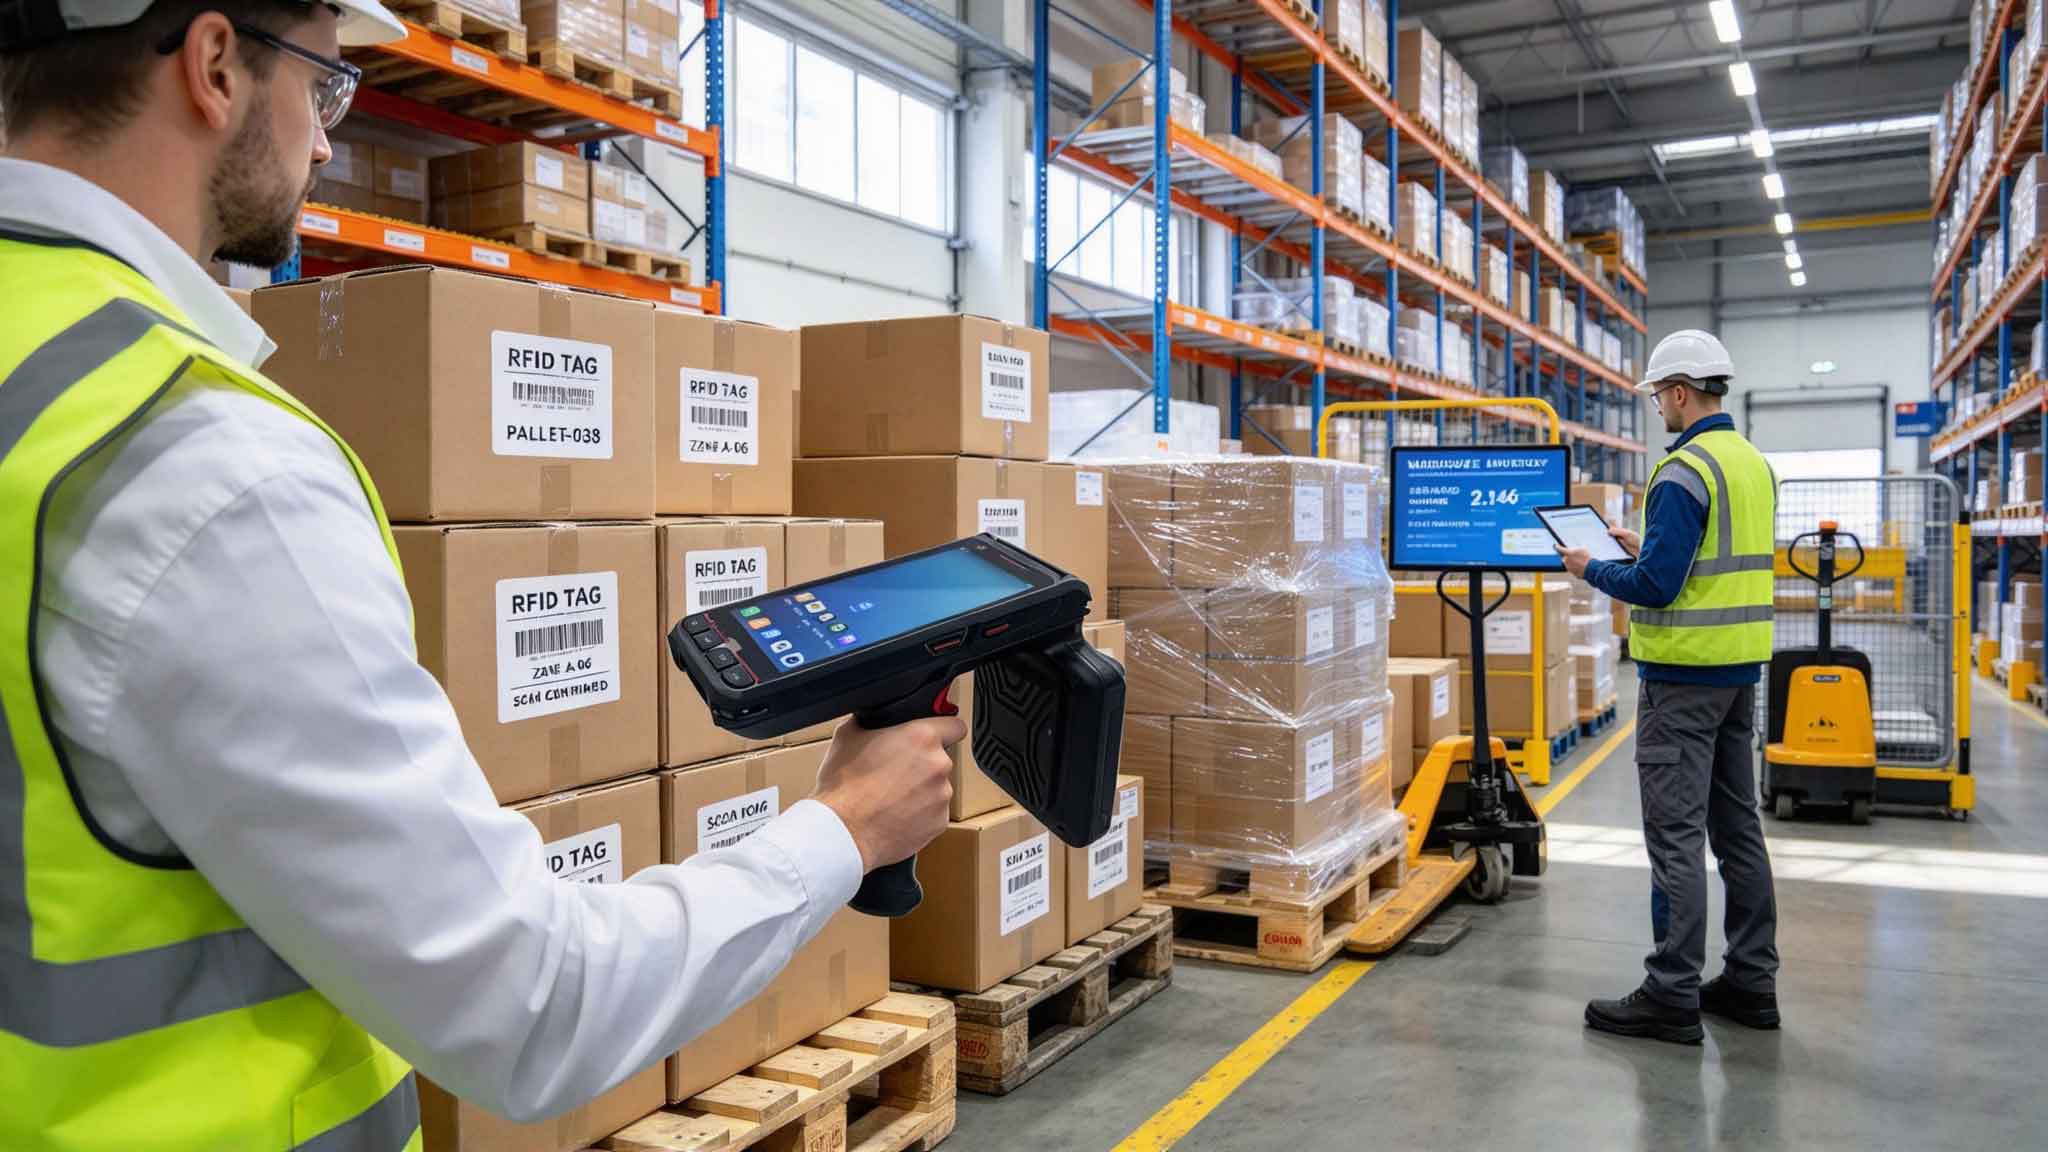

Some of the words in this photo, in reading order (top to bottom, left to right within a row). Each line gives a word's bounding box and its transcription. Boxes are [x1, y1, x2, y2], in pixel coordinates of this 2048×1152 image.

[508, 347, 555, 370] RFID
[561, 353, 598, 375] TAG
[722, 382, 748, 399] TAG
[695, 560, 726, 578] RFID
[730, 557, 757, 574] TAG
[511, 590, 558, 615] RFID
[563, 585, 602, 608] TAG
[568, 841, 607, 868] TAG
